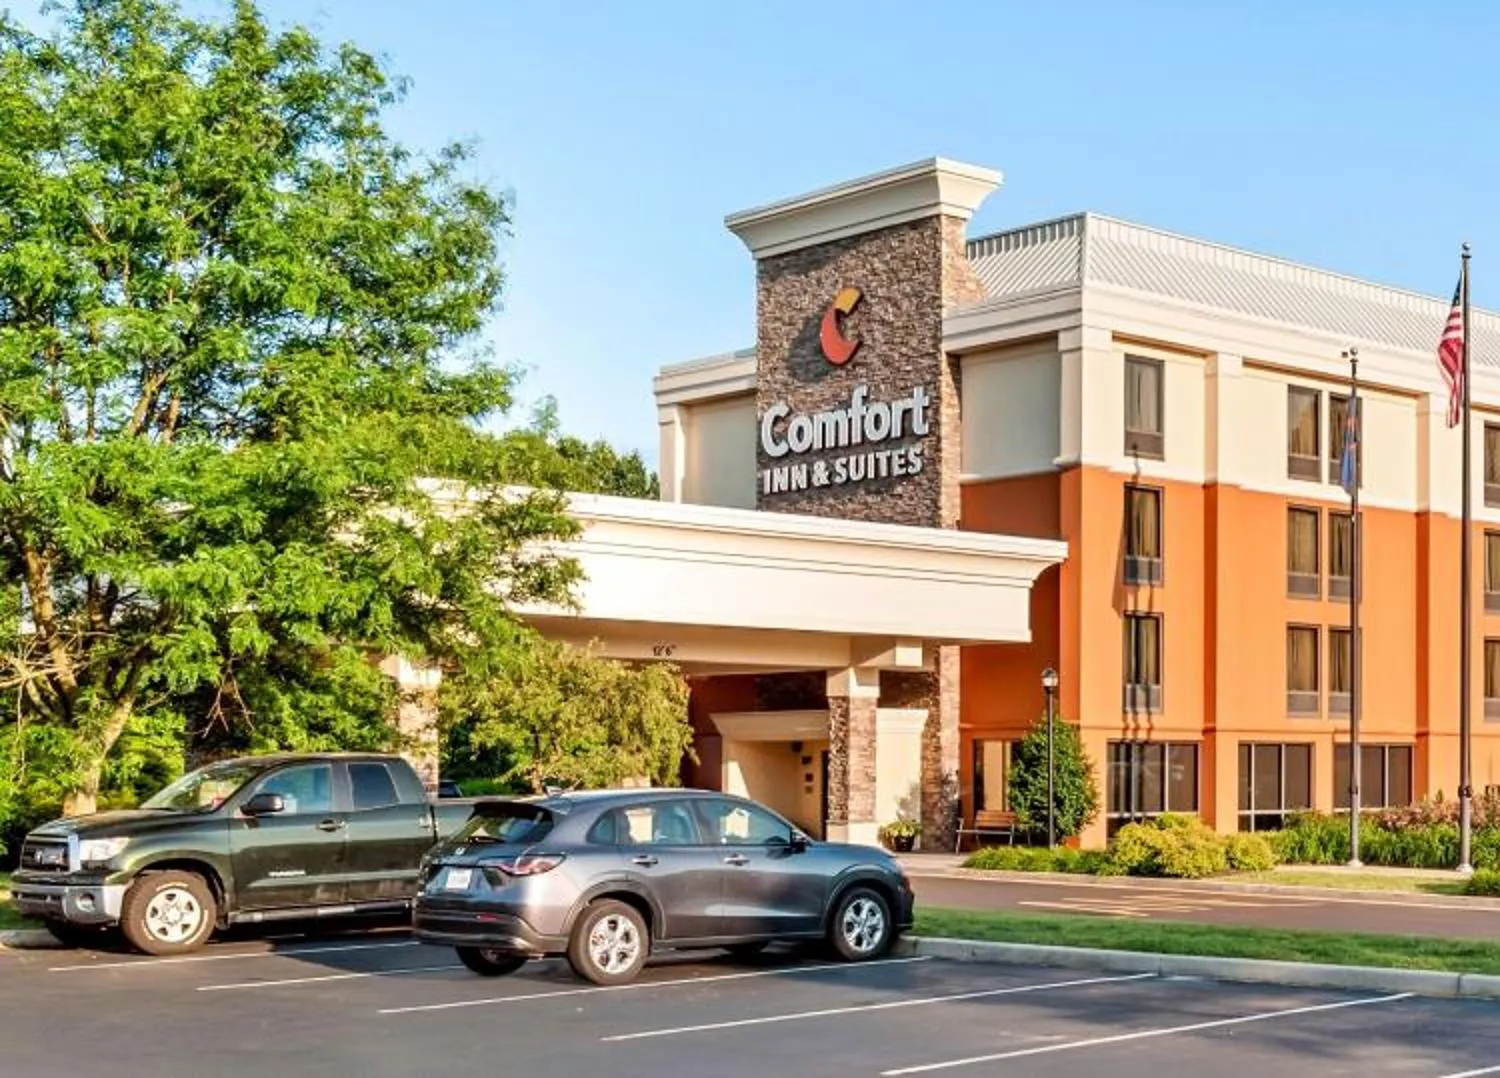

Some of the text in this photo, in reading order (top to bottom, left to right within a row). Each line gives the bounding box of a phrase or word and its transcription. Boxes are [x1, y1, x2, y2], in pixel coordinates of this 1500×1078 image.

[761, 385, 929, 458] Comfort
[763, 443, 924, 495] INN & SUITES
